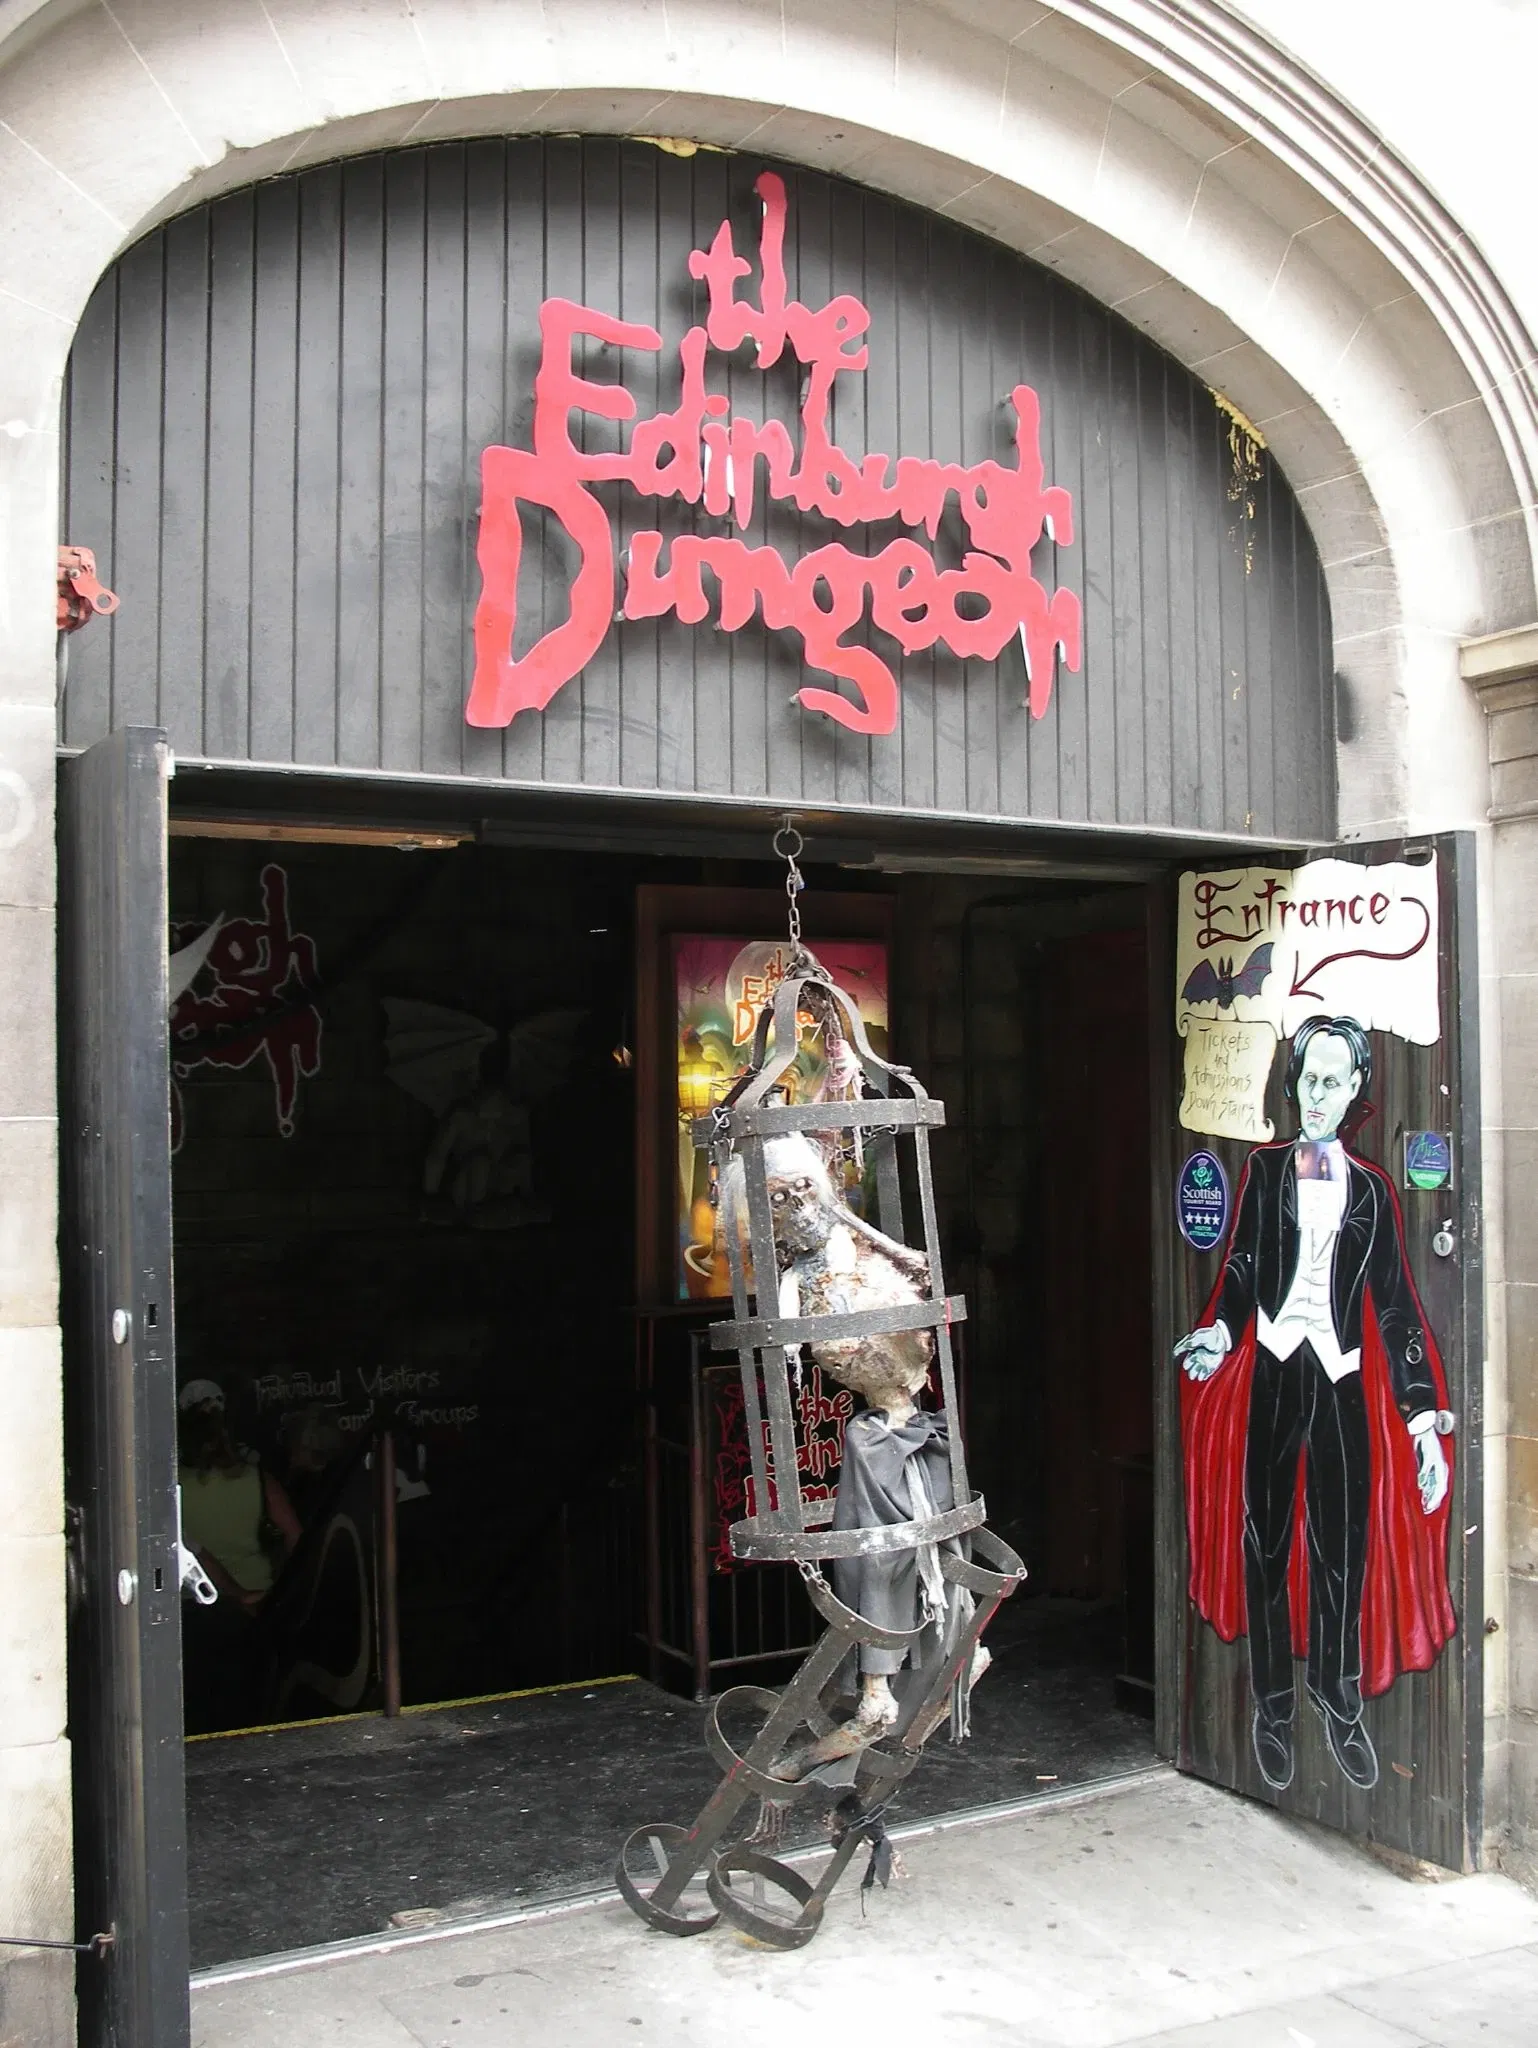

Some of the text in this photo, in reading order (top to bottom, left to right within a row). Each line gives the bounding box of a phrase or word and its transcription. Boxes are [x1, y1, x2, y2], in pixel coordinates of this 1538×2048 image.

[687, 171, 871, 369] the
[533, 297, 1074, 560] Edinburgh
[465, 446, 1083, 735] Dungeon
[1193, 877, 1391, 950] Entrance
[1198, 1027, 1251, 1054] Tickets
[1191, 1064, 1253, 1093] Admissions
[1185, 1091, 1256, 1130] Down Stairs
[1182, 1184, 1222, 1201] Scottish
[356, 1363, 442, 1397] Visitors
[797, 1364, 854, 1428] the
[395, 1399, 480, 1432] Groups
